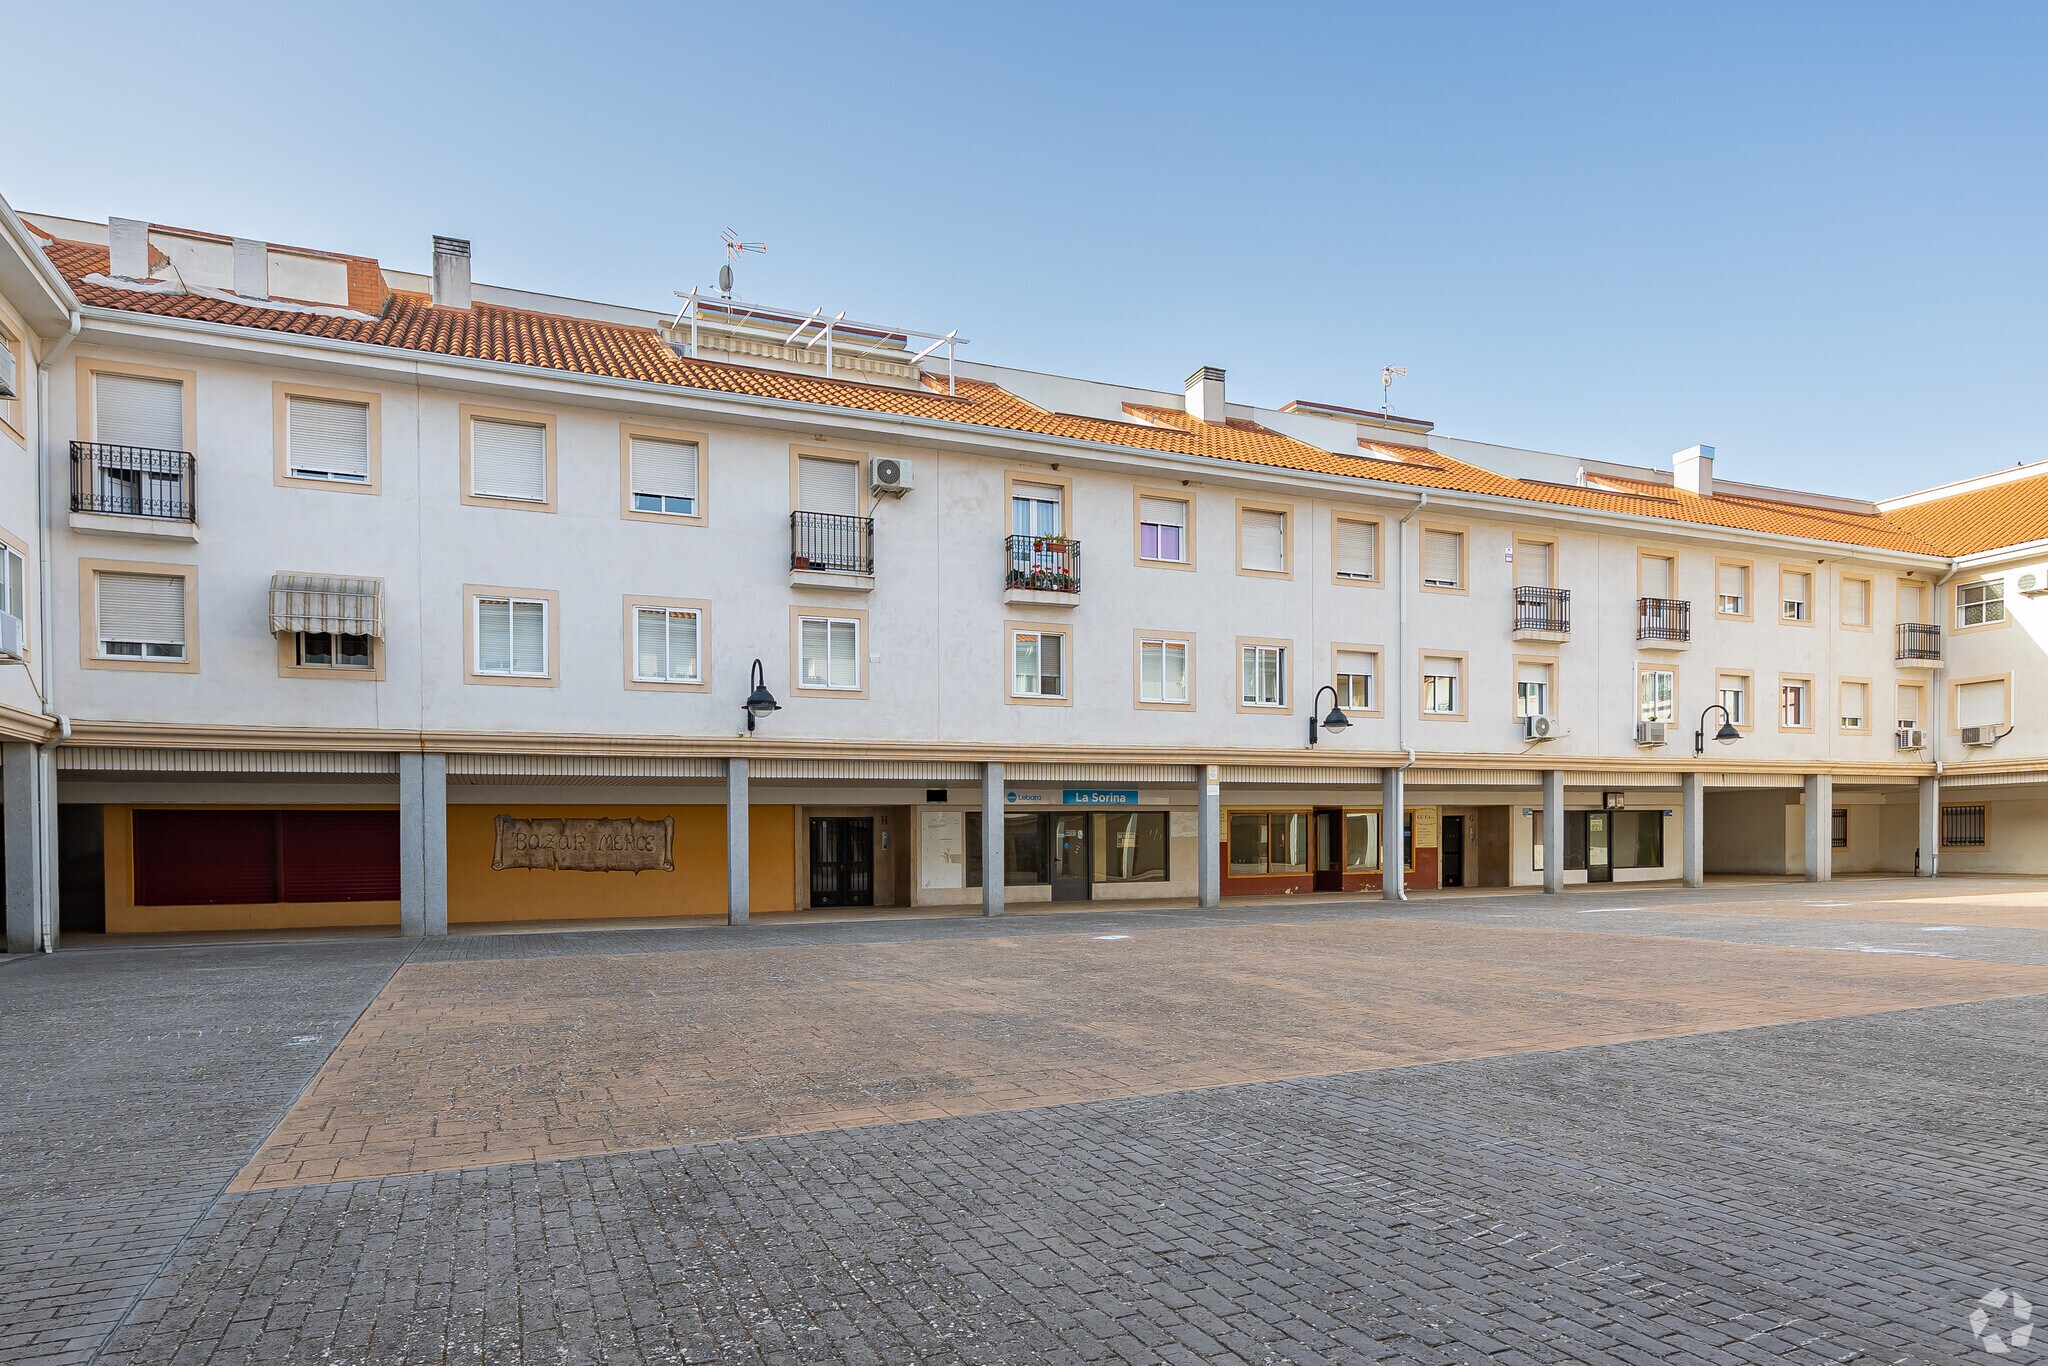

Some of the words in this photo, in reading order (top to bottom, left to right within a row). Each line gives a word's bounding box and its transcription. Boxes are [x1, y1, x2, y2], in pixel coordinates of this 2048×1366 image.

[1075, 792, 1089, 803] La
[1091, 792, 1126, 803] Sorina
[881, 815, 888, 825] H
[596, 832, 655, 852] MERCE
